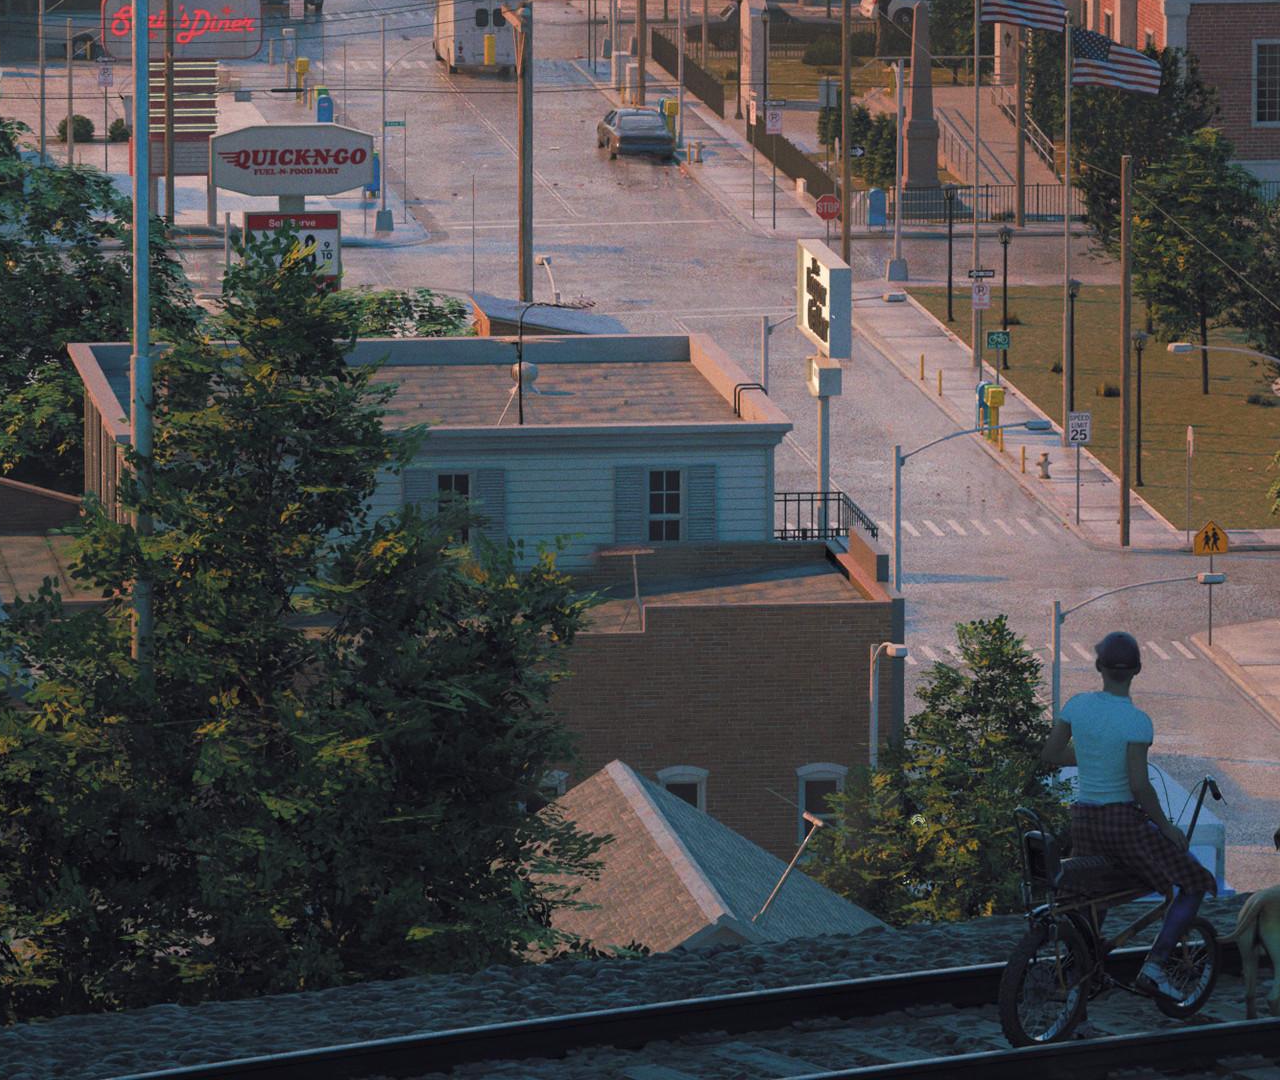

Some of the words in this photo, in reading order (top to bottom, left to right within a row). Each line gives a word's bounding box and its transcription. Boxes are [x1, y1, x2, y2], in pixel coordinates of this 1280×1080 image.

[176, 8, 257, 46] Diner
[253, 168, 277, 176] FUEL
[289, 167, 314, 176] FOOD
[314, 167, 340, 175] MART
[817, 202, 840, 214] STOP
[1071, 429, 1087, 441] 25
